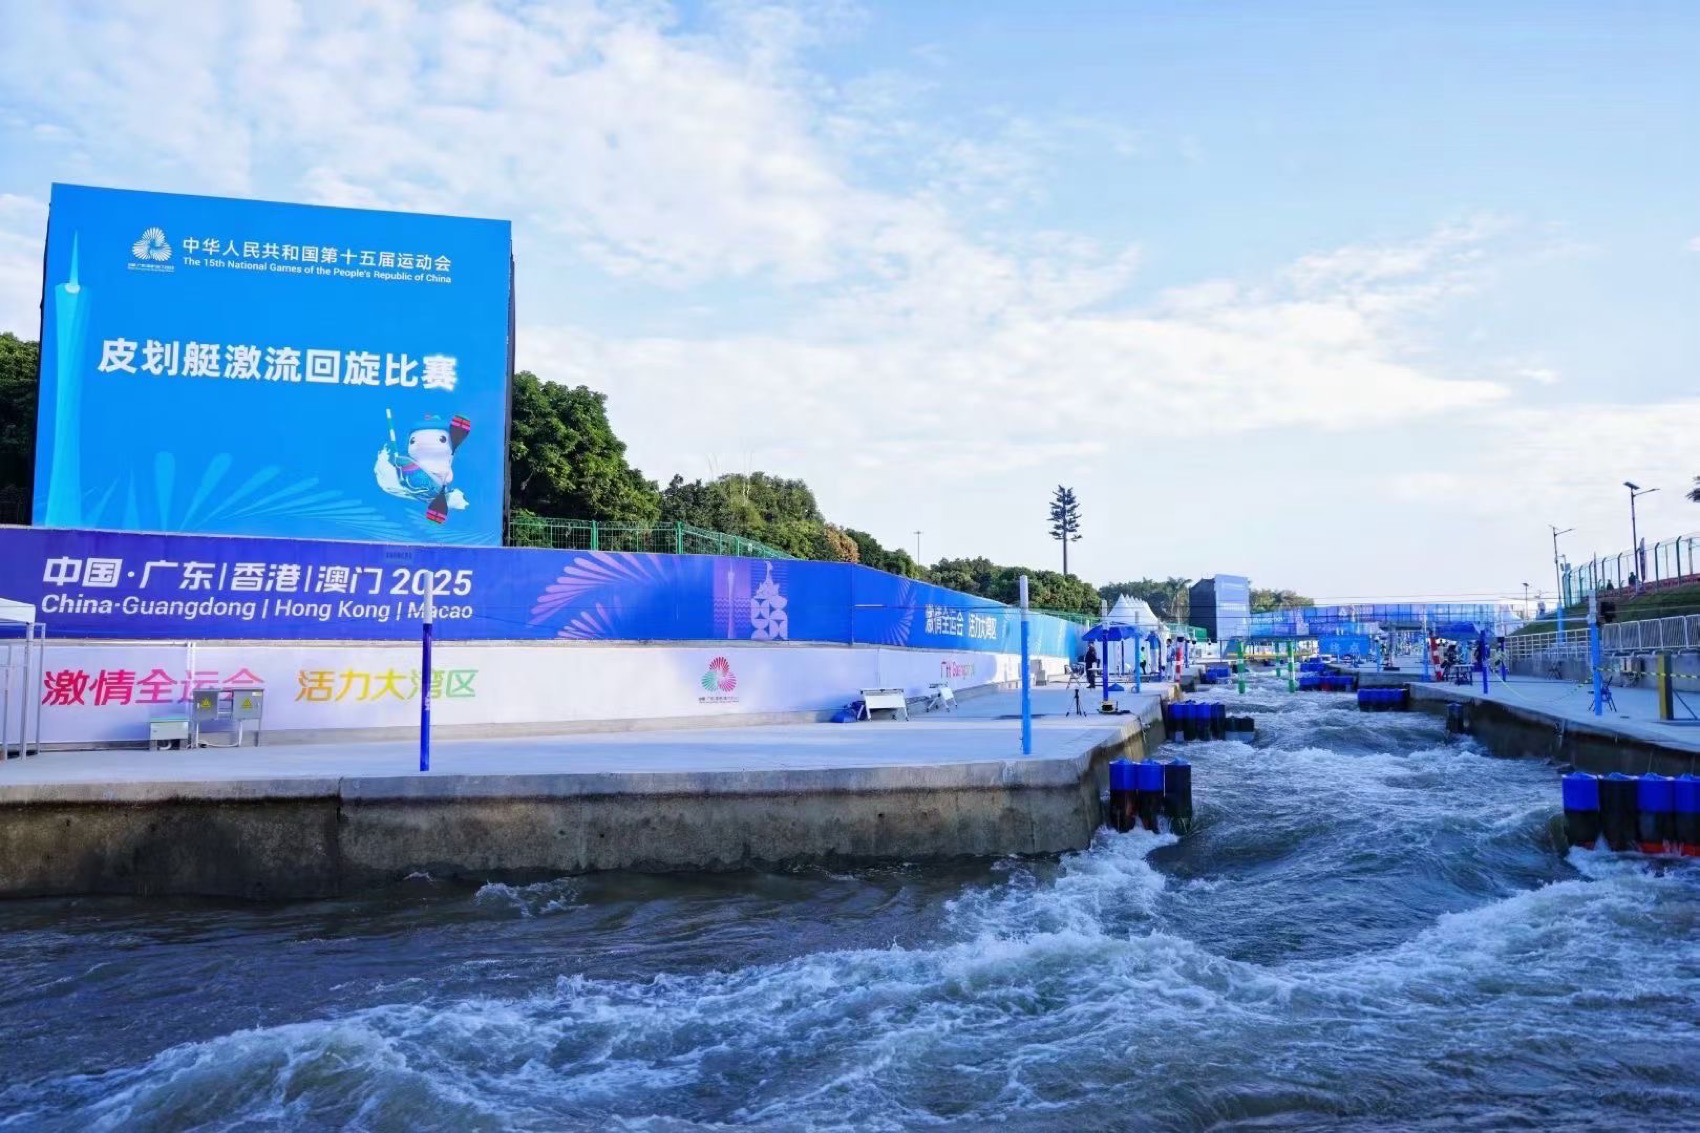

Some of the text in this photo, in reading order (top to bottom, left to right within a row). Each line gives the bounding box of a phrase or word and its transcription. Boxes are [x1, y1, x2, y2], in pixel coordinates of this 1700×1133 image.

[182, 236, 452, 272] 中华人民共和国第十五届运动会
[183, 257, 452, 283] The 15th National Games of the People's Republic of China
[98, 337, 459, 392] 皮划艇激流回旋比赛
[390, 568, 473, 596] 2025
[274, 598, 333, 622] Hong
[337, 600, 391, 623] Kong
[407, 602, 473, 619] Macao
